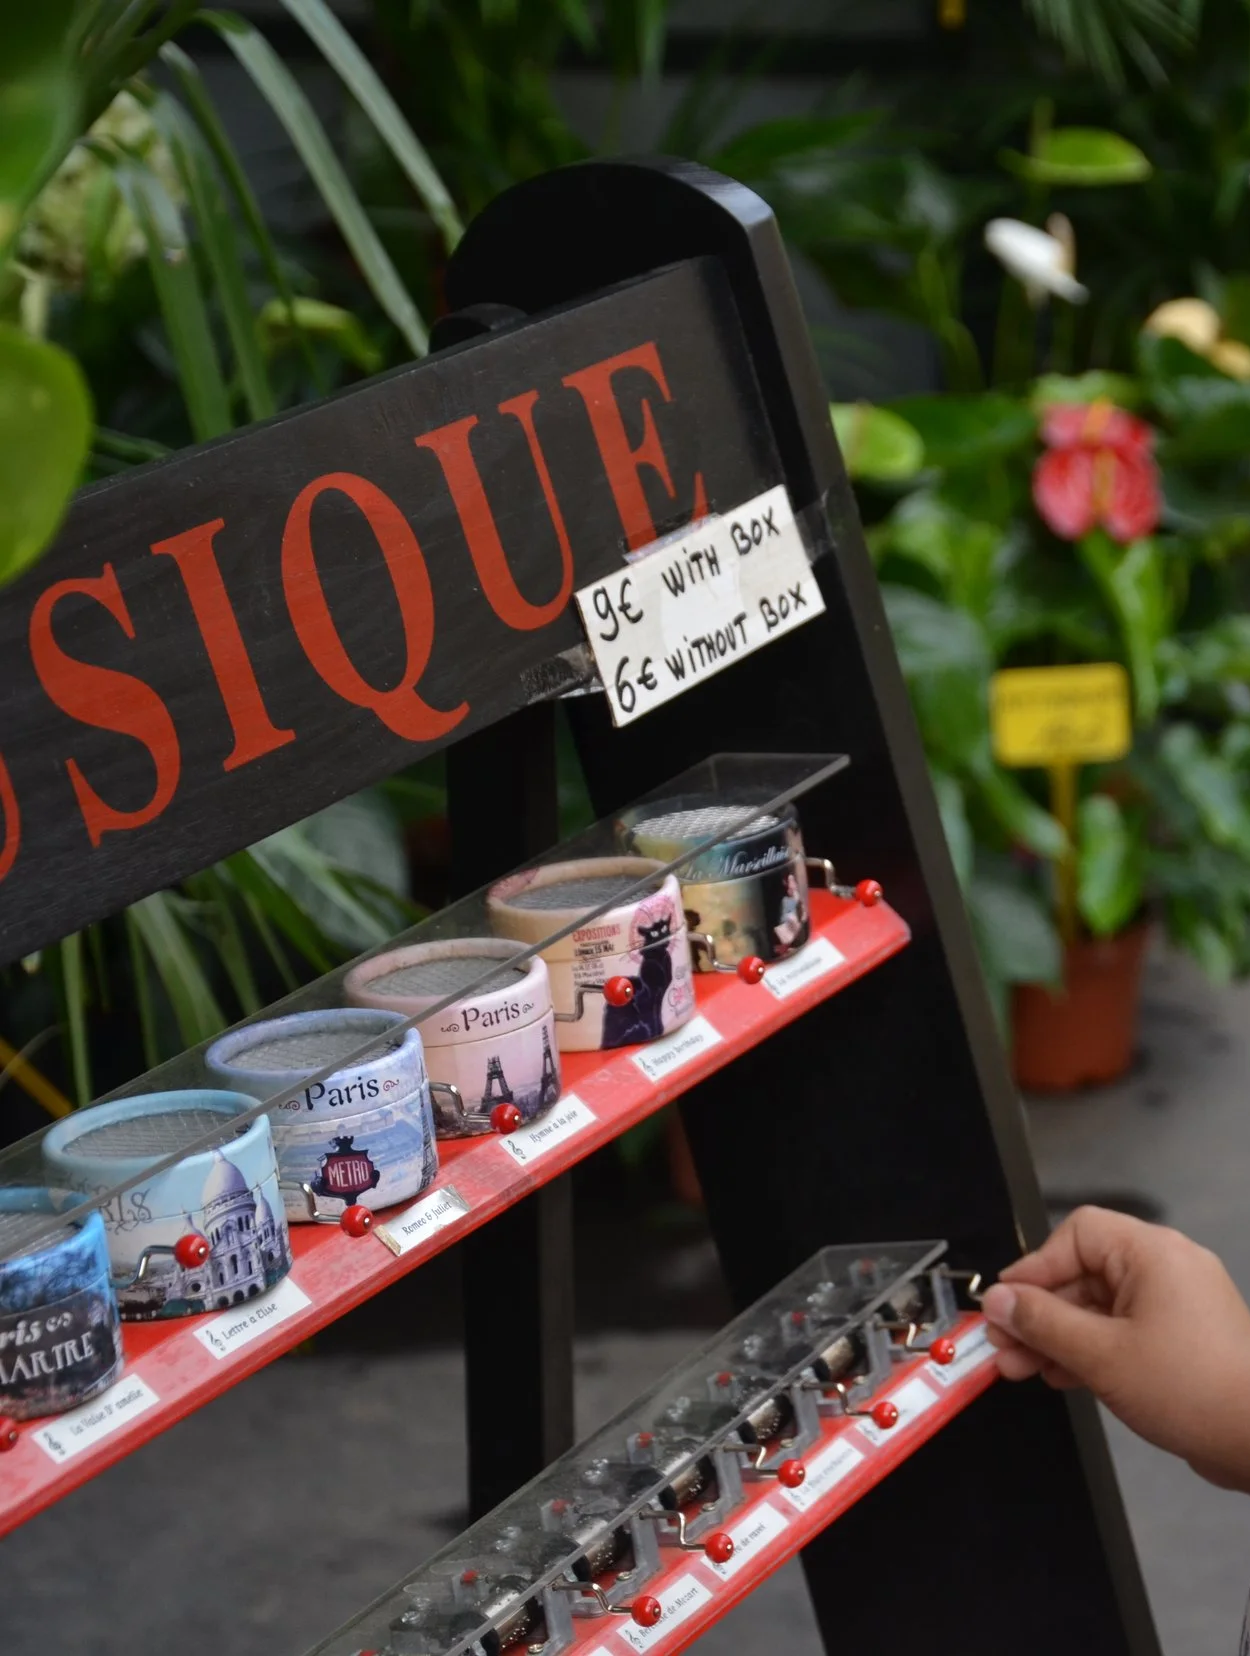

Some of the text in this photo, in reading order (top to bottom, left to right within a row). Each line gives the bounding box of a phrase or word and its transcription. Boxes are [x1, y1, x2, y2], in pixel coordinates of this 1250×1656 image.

[592, 577, 644, 641] 9€
[730, 506, 780, 556] BOX
[0, 342, 707, 884] SIQUE
[615, 655, 658, 713] 6€
[759, 581, 808, 632] BOX
[461, 1001, 521, 1031] Paris
[305, 1076, 380, 1111] Paris
[328, 1160, 370, 1188] METRO
[401, 1199, 453, 1236] Romeo & Juliet
[221, 1318, 249, 1340] Lettre
